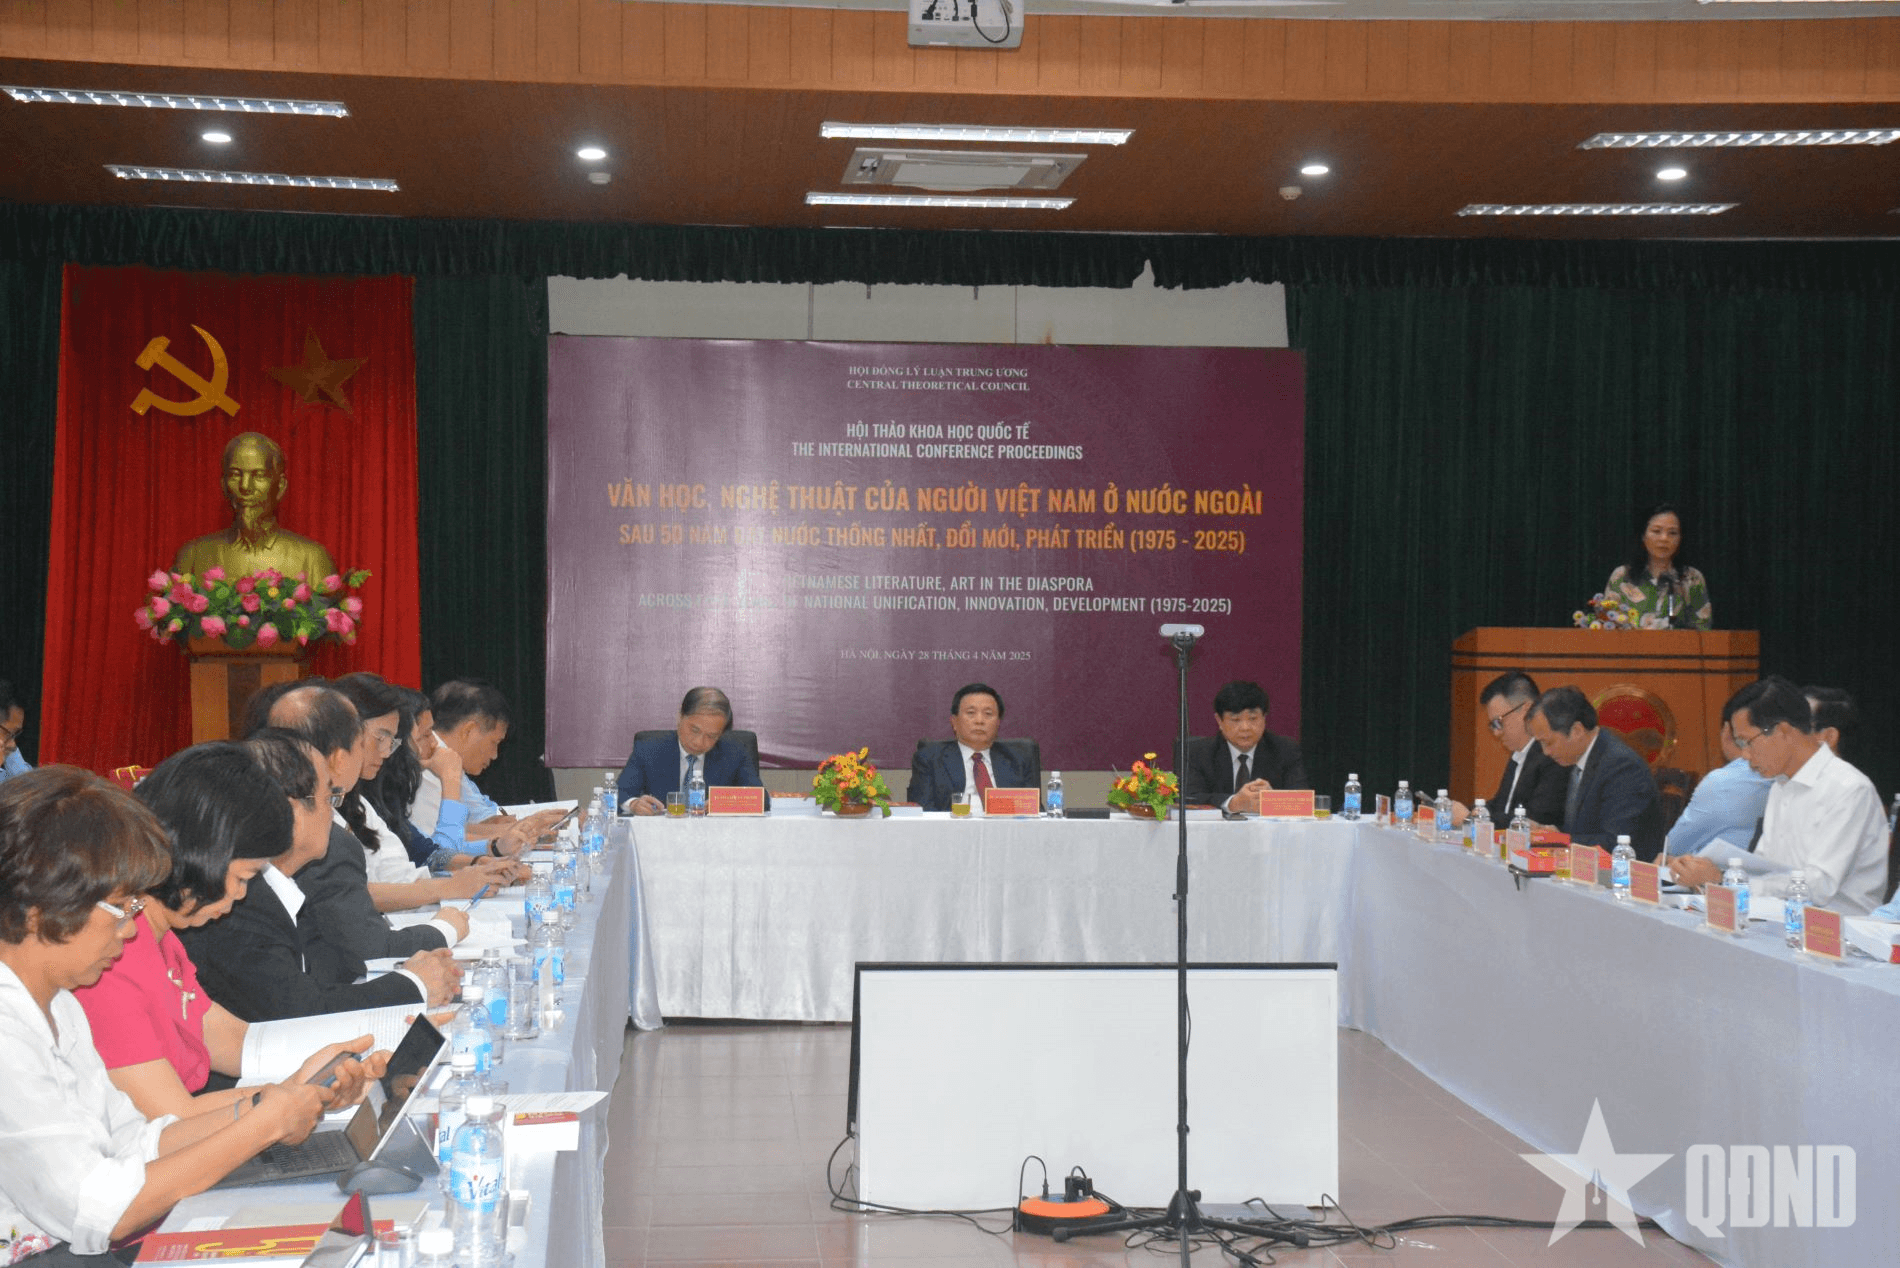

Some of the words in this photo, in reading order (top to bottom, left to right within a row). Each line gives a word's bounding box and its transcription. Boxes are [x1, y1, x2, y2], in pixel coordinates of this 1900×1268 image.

[906, 364, 920, 376] LÝ
[955, 367, 993, 377] TRUNG
[847, 380, 899, 390] CENTRAL
[901, 381, 979, 391] THEORETICAL
[980, 382, 1030, 391] COUNCIL
[847, 420, 869, 441] HỘI
[872, 419, 905, 439] THẢO
[909, 424, 943, 439] KHOA
[948, 424, 974, 442] HỌC
[977, 421, 1012, 441] QUỐC
[1016, 420, 1032, 440] TẾ
[792, 442, 815, 457] THE
[818, 442, 913, 458] INTERNATIONAL
[916, 443, 994, 459] CONFERENCE
[998, 444, 1083, 460] PROCEEDINGS
[607, 477, 651, 508] VĂN
[721, 480, 780, 515] NGHỆ
[787, 480, 858, 516] THUẬT
[865, 479, 909, 512] CỦA
[916, 480, 987, 513] NGƯỜI
[994, 482, 1041, 518] VIỆT
[1047, 488, 1096, 514] NAM
[1103, 481, 1119, 514] Ở
[1125, 483, 1187, 515] NƯỚC
[1194, 483, 1263, 516] NGOÀI
[619, 524, 655, 545] SAU
[660, 524, 684, 545] 50
[771, 519, 821, 547] NƯỚC
[827, 522, 886, 548] THỐNG
[945, 519, 976, 549] ĐỔI
[1025, 523, 1071, 550] PHÁT
[1076, 521, 1125, 550] TRIỂN
[1130, 529, 1176, 554] (1975
[1194, 530, 1246, 555] 2025)
[865, 575, 946, 592] LITERATURE,
[950, 576, 975, 591] ART
[980, 577, 994, 591] IN
[998, 577, 1022, 591] THE
[1027, 577, 1094, 592] DIASPORA
[639, 593, 692, 608] ACROSS
[804, 595, 869, 610] NATIONAL
[873, 596, 961, 612] UNIFICATION,
[964, 597, 1049, 613] INNOVATION,
[1052, 597, 1146, 613] DEVELOPMENT
[1151, 598, 1232, 615] (1975-2025)
[840, 649, 857, 660] HÀ
[884, 648, 916, 660] NGÀY
[918, 650, 930, 660] 28
[932, 649, 970, 660] THÁNG
[972, 651, 979, 660] 4
[981, 649, 1006, 660] NĂM
[1009, 650, 1031, 661] 2025
